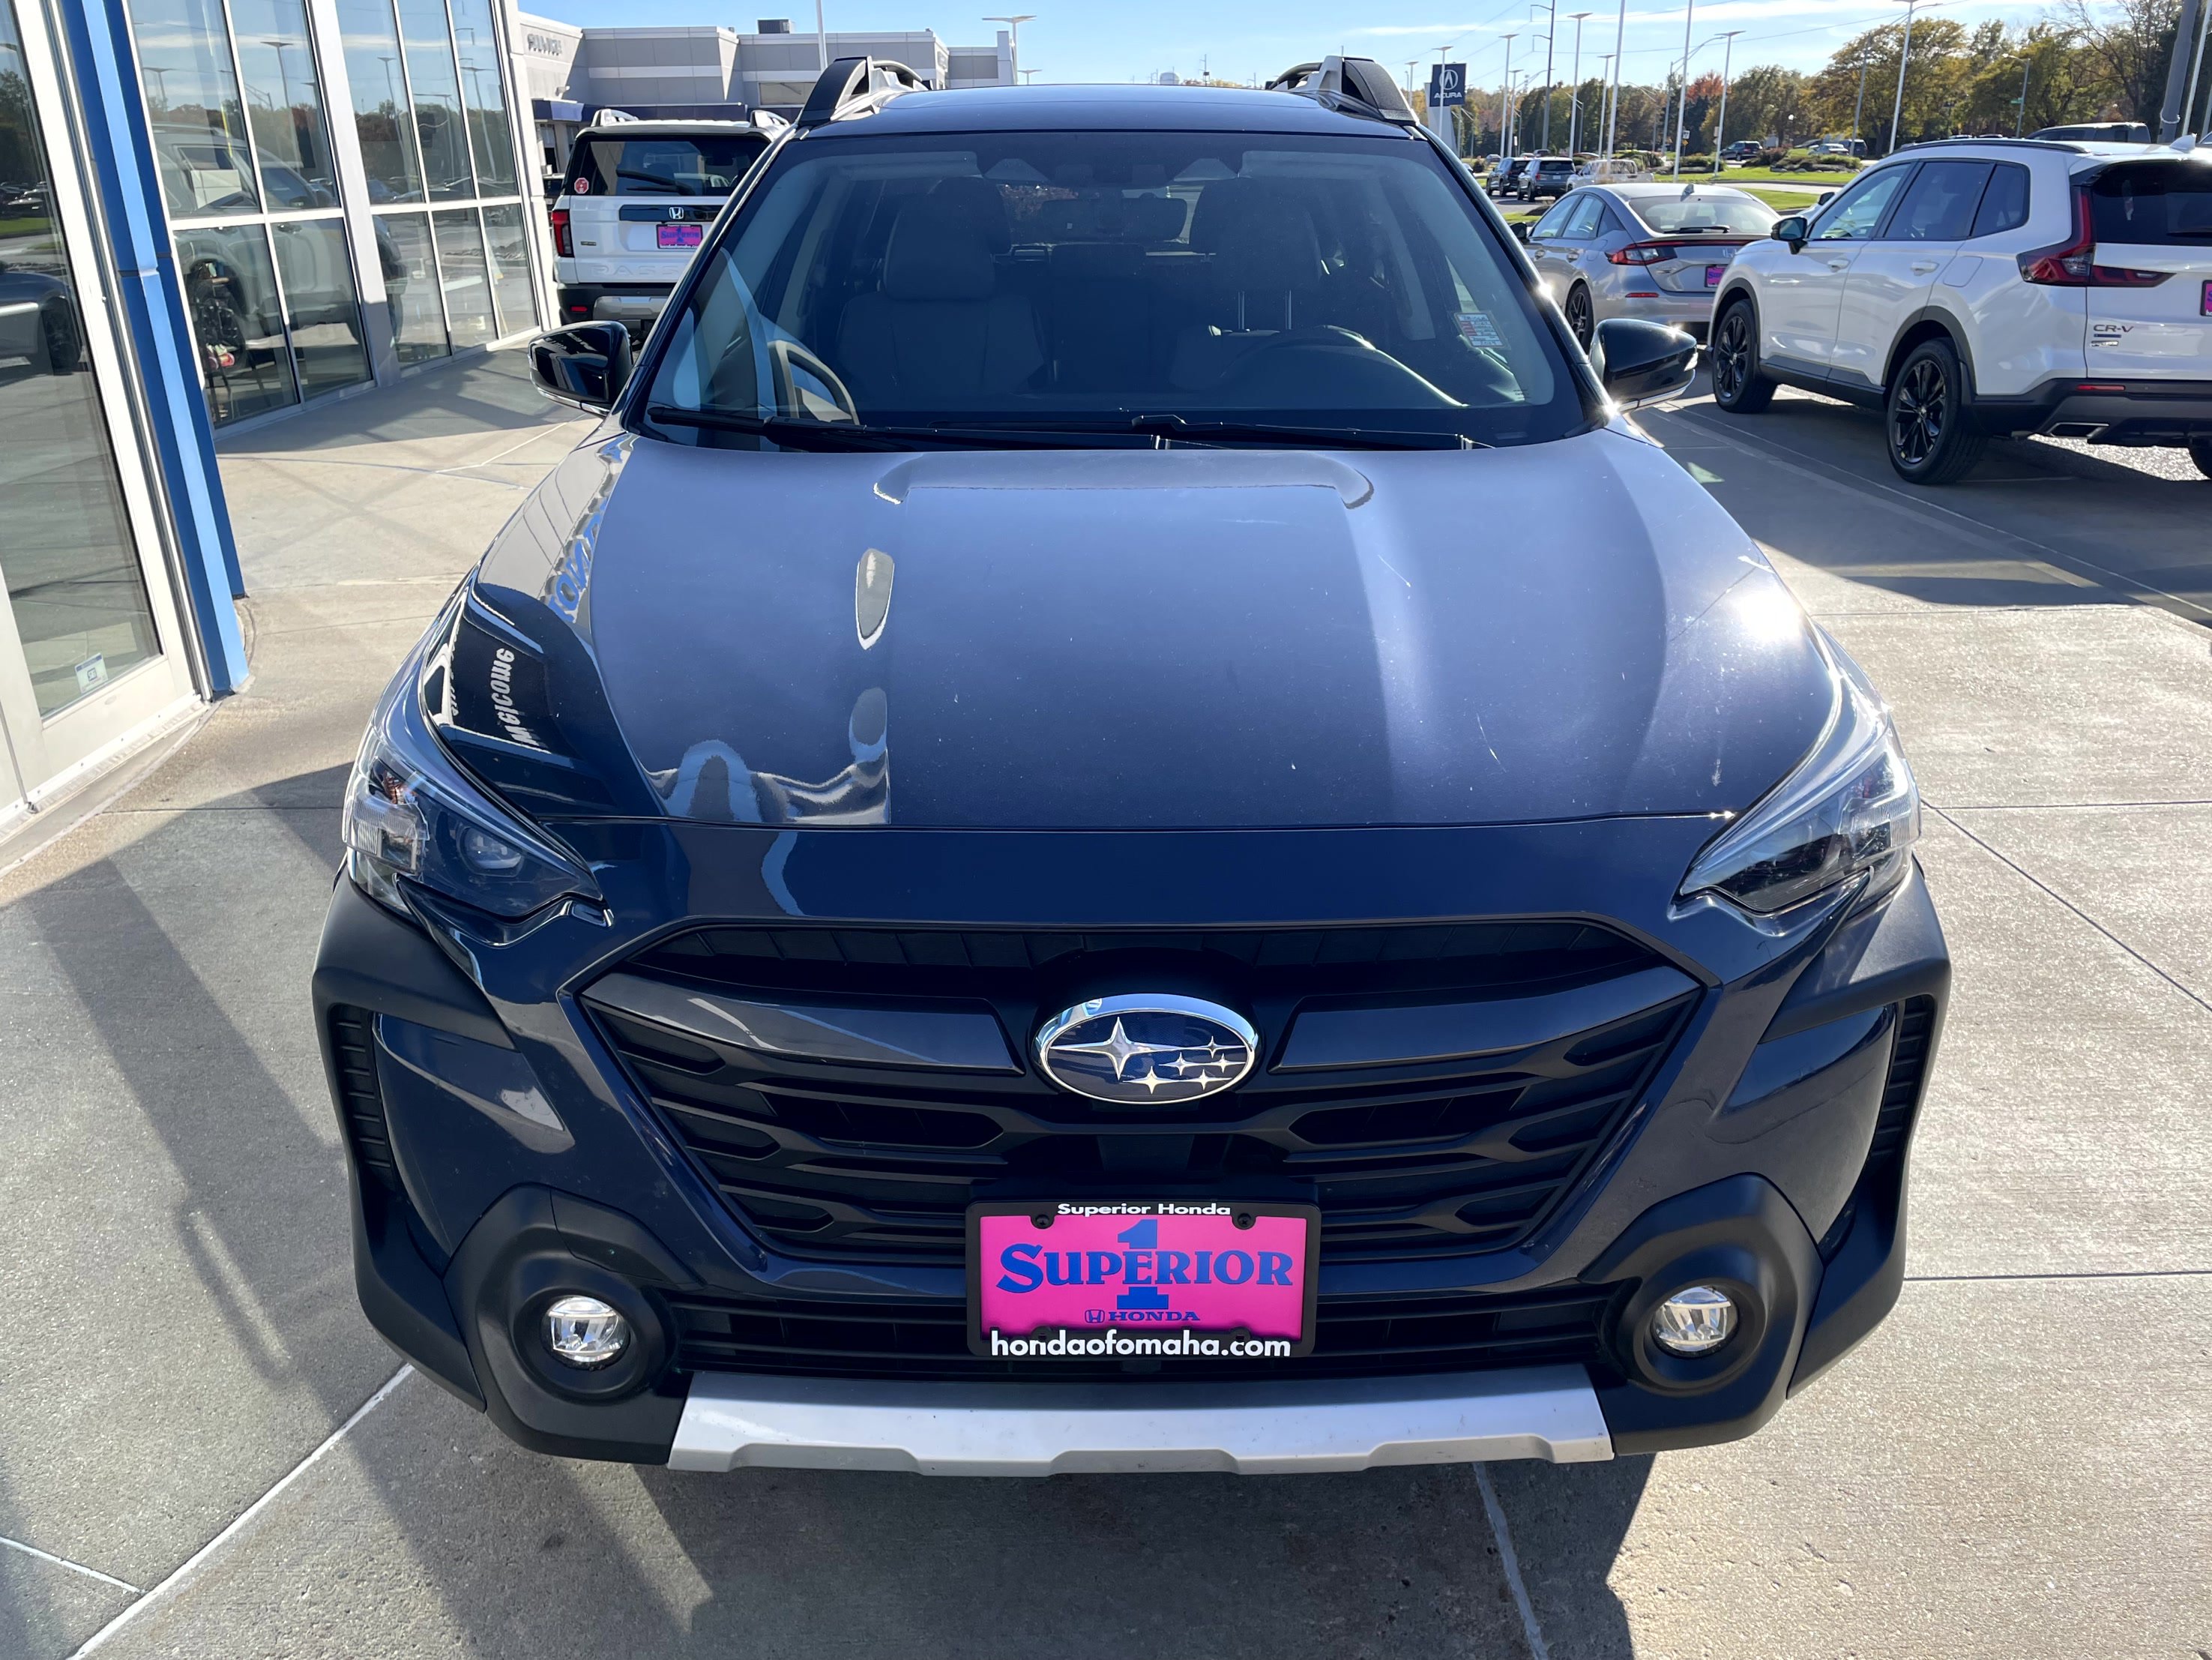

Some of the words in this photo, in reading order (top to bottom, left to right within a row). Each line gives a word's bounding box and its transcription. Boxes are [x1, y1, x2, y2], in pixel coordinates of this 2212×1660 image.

[1057, 1203, 1151, 1217] Superior
[1158, 1203, 1231, 1215] Honda
[995, 1243, 1293, 1293] SUPERIOR
[1109, 1311, 1201, 1321] HONDA
[991, 1329, 1291, 1357] hondaofomaha.com
